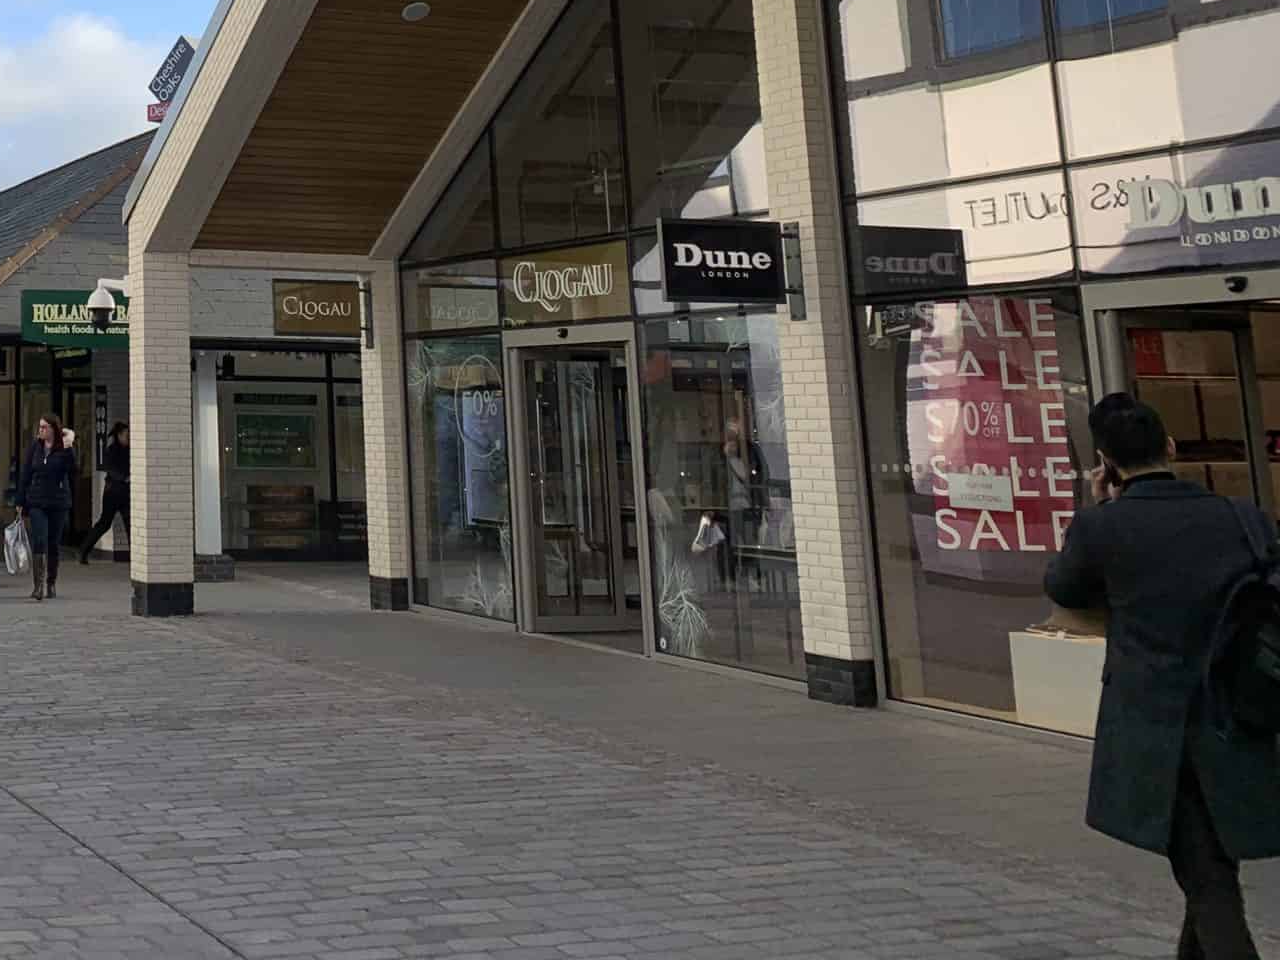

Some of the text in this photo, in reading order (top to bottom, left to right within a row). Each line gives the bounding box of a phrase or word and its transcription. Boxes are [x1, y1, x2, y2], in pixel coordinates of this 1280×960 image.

[151, 43, 187, 92] Cheshire
[159, 72, 181, 101] Oaks
[673, 243, 772, 270] Dune
[701, 271, 749, 279] LONDON
[32, 304, 94, 321] HOLLAN
[915, 298, 1056, 338] SALE
[44, 325, 70, 334] health
[72, 325, 95, 334] foods
